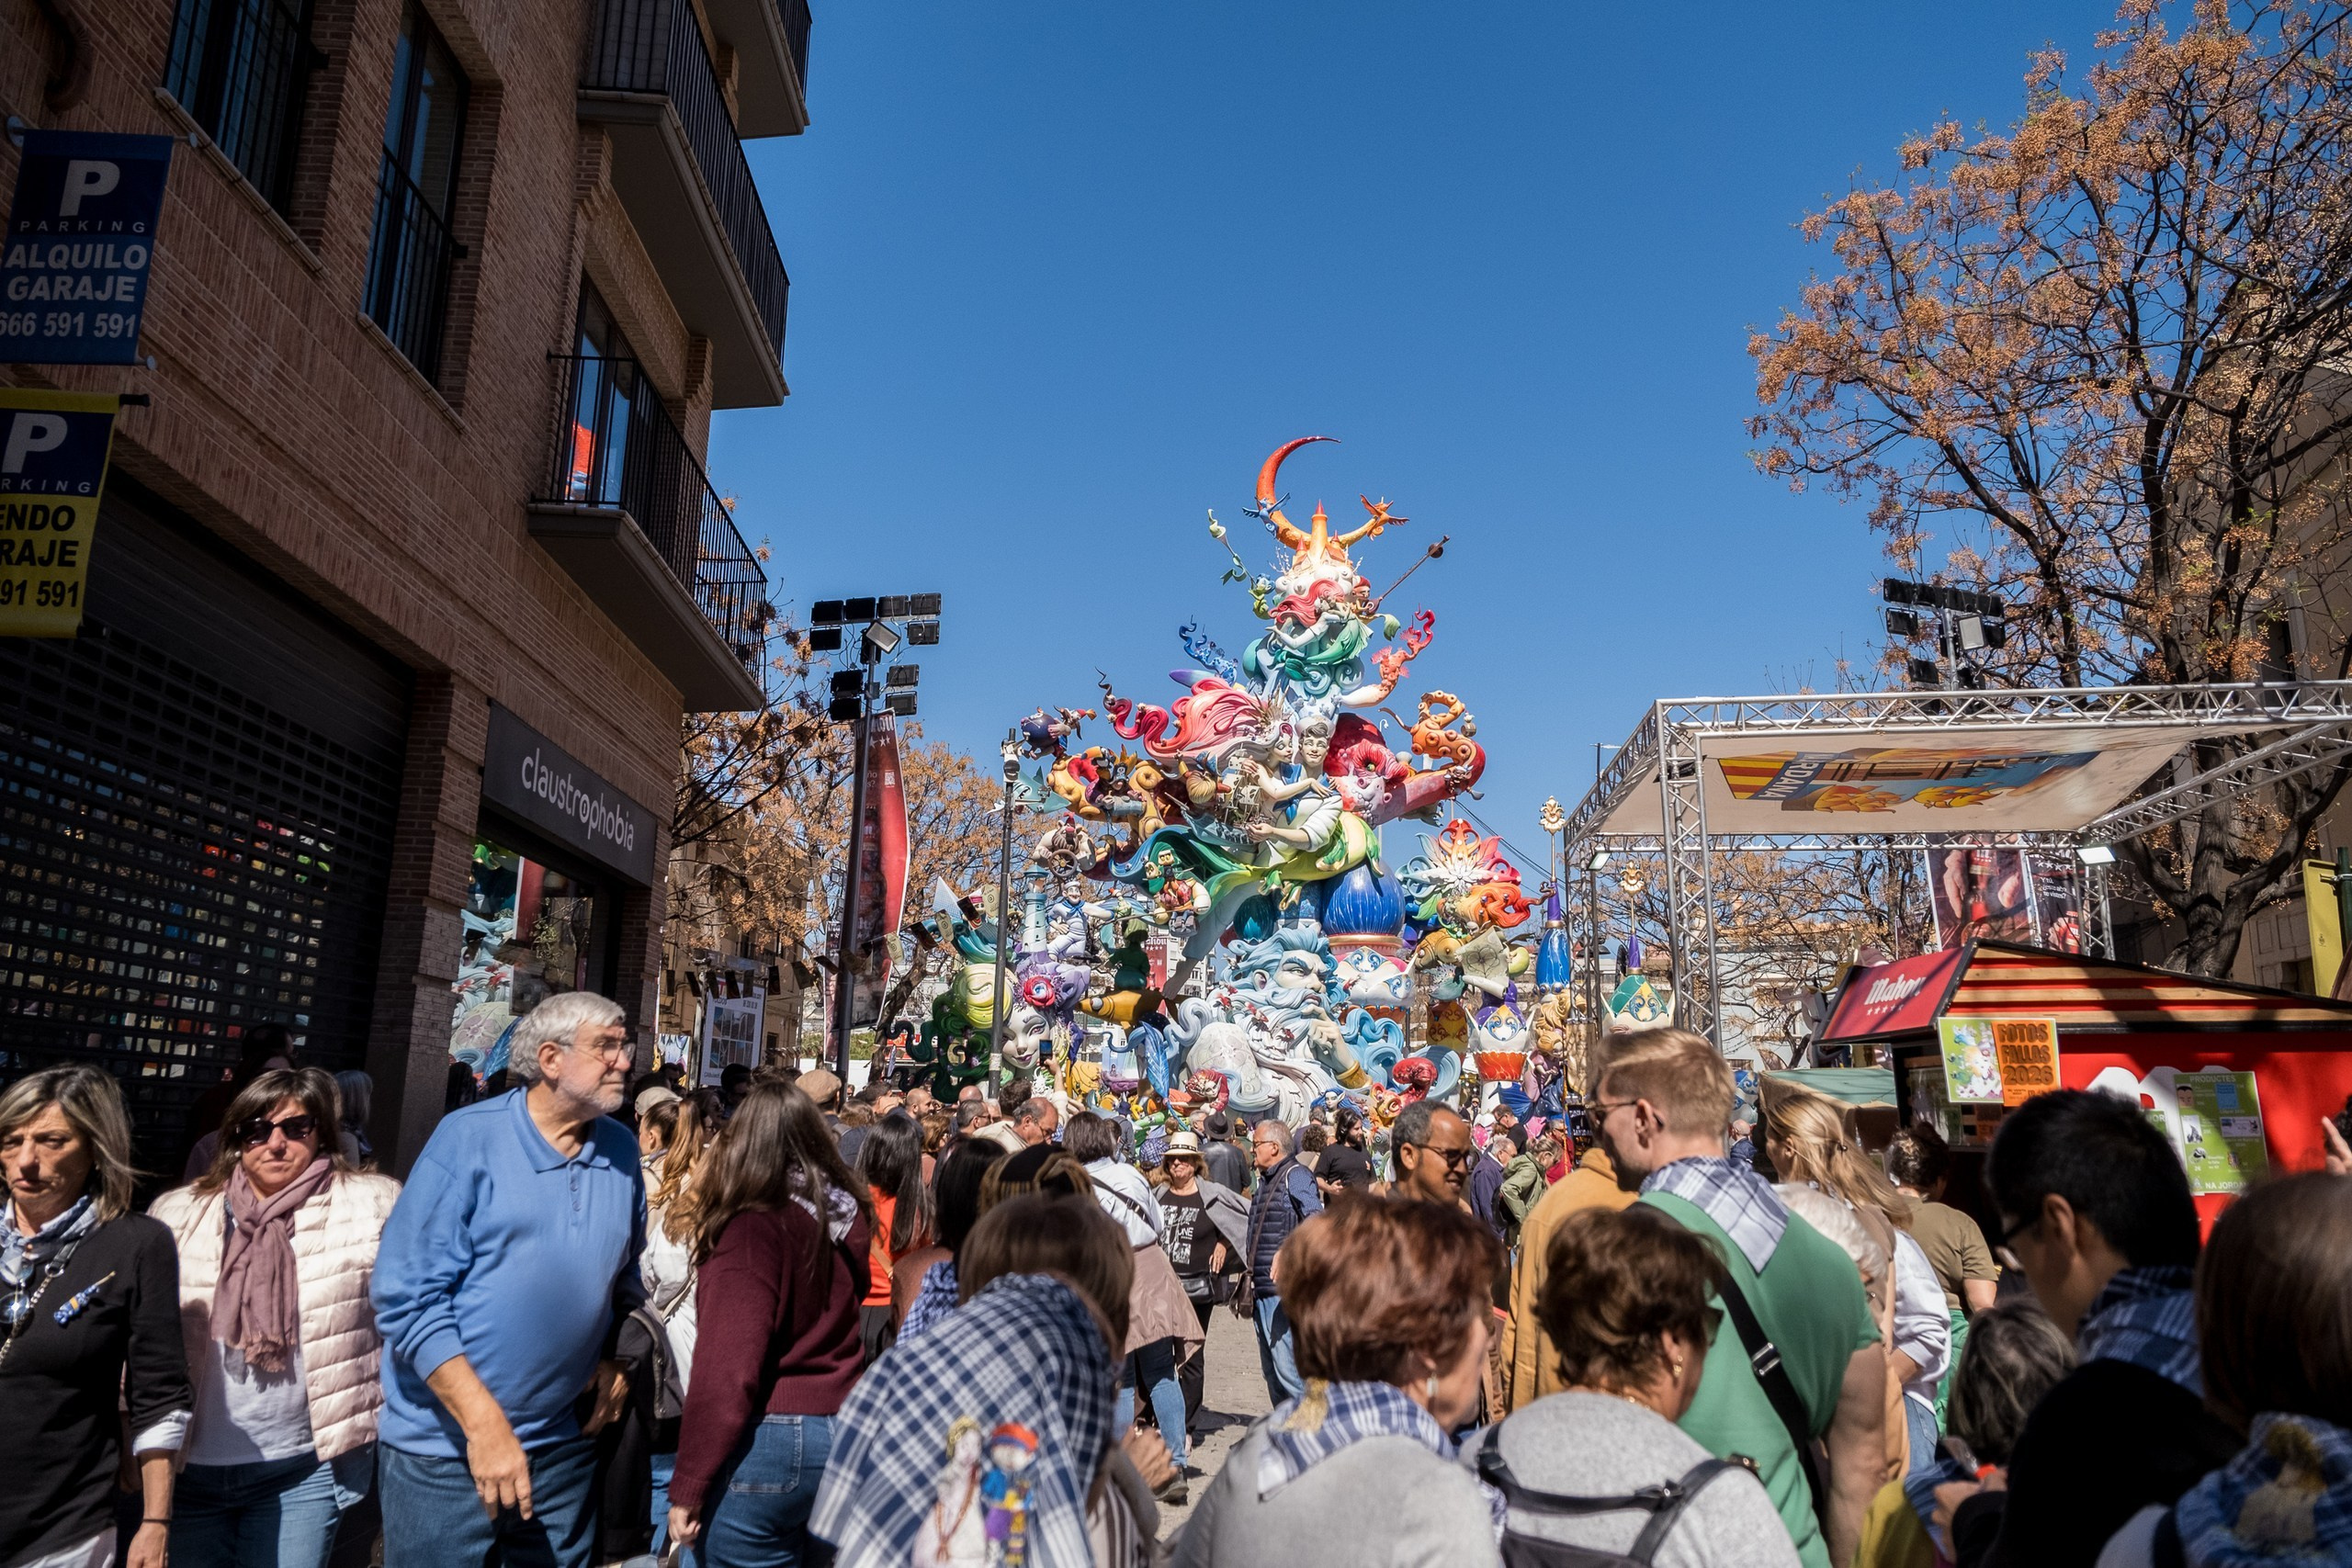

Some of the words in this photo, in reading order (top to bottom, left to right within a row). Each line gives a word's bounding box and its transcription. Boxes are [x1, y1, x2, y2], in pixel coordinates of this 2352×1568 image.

[59, 160, 120, 217] P
[20, 220, 145, 233] PARKING
[5, 243, 148, 270] ALQUILO
[7, 276, 137, 302] GARAJE
[43, 311, 85, 337] 591
[93, 313, 136, 338] 591
[2, 412, 68, 474] P
[0, 479, 91, 493] RKING
[0, 504, 76, 532] NDO
[0, 538, 79, 568] RAJE
[0, 579, 28, 607] 91
[36, 581, 79, 607] 591
[521, 747, 635, 852] claustrophobia
[1864, 974, 1927, 1005] Mahou
[1997, 1023, 2049, 1043] FOTOS
[2001, 1044, 2052, 1065] FALLAS
[2003, 1066, 2054, 1086] 2026
[2189, 1075, 2236, 1083] PRODUCTES
